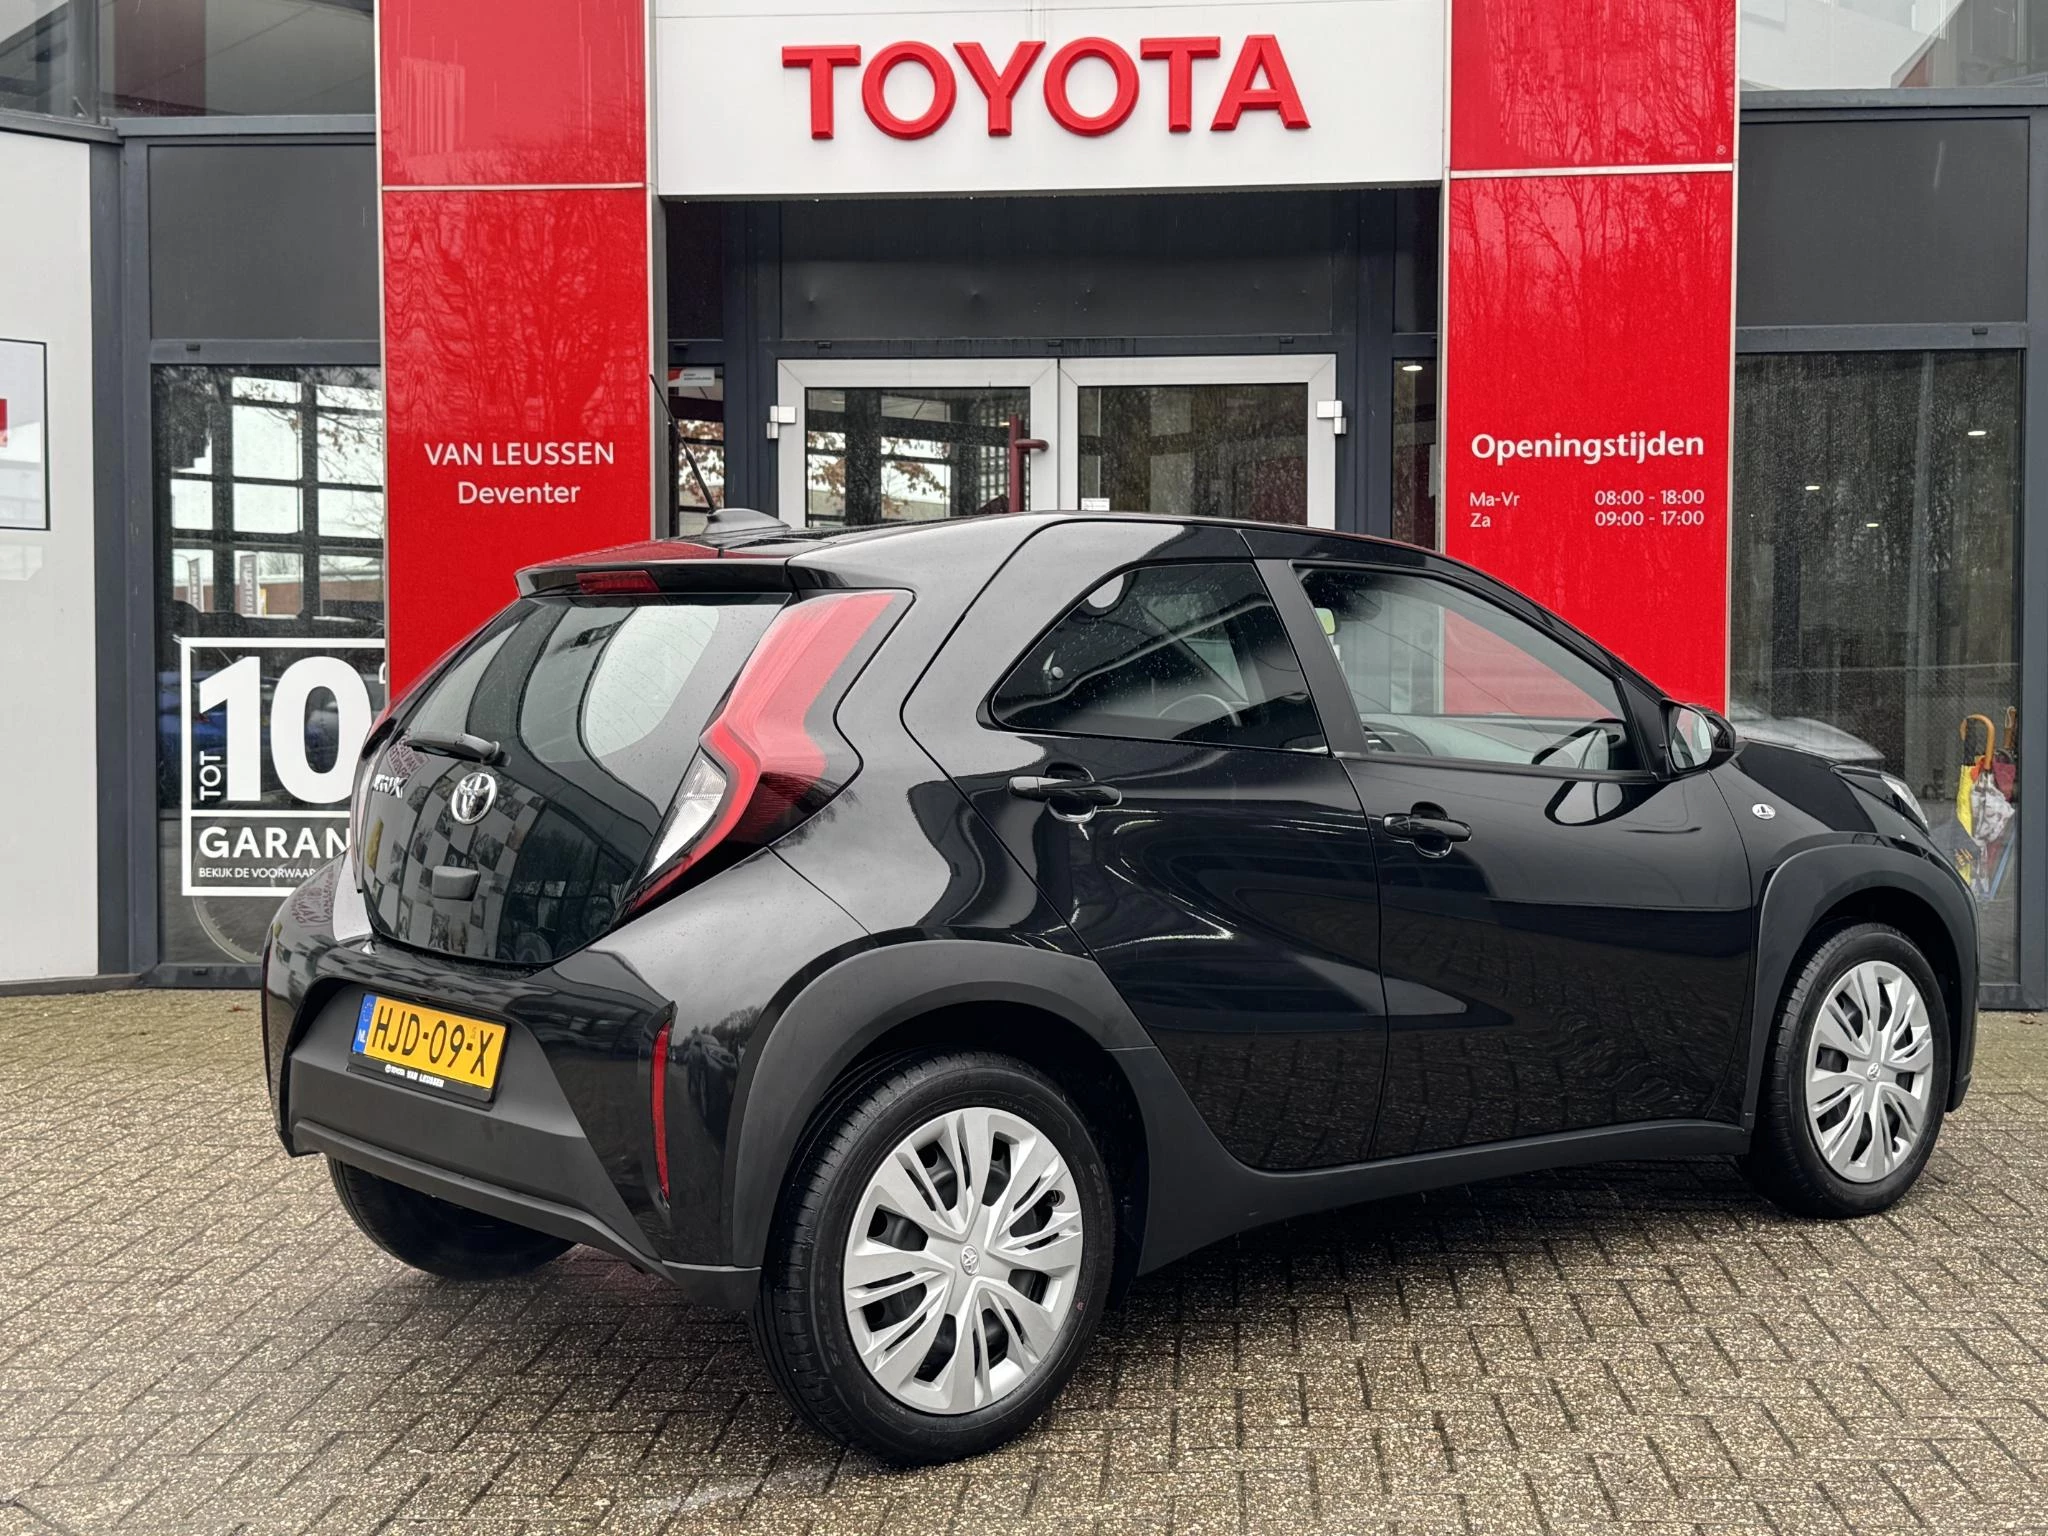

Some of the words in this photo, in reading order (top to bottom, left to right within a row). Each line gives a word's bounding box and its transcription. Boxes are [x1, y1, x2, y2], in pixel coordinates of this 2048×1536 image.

[782, 34, 1312, 140] TOYOTA
[424, 442, 483, 466] VAN
[492, 441, 615, 466] LEUSSEN
[1471, 430, 1704, 466] Openingstijden
[457, 481, 581, 504] Deventer
[1469, 491, 1520, 507] Ma-Vr
[1594, 489, 1644, 505] 08:00
[1660, 488, 1705, 505] 18:00
[1469, 512, 1491, 528] Za
[1594, 510, 1644, 526] 09:00
[1660, 509, 1705, 526] 17:00
[199, 656, 373, 804] 10
[199, 750, 222, 801] TOT
[198, 826, 351, 859] GARAN
[199, 867, 233, 879] BEKIJK
[234, 868, 250, 878] DE
[371, 1005, 495, 1078] HJD-09-X
